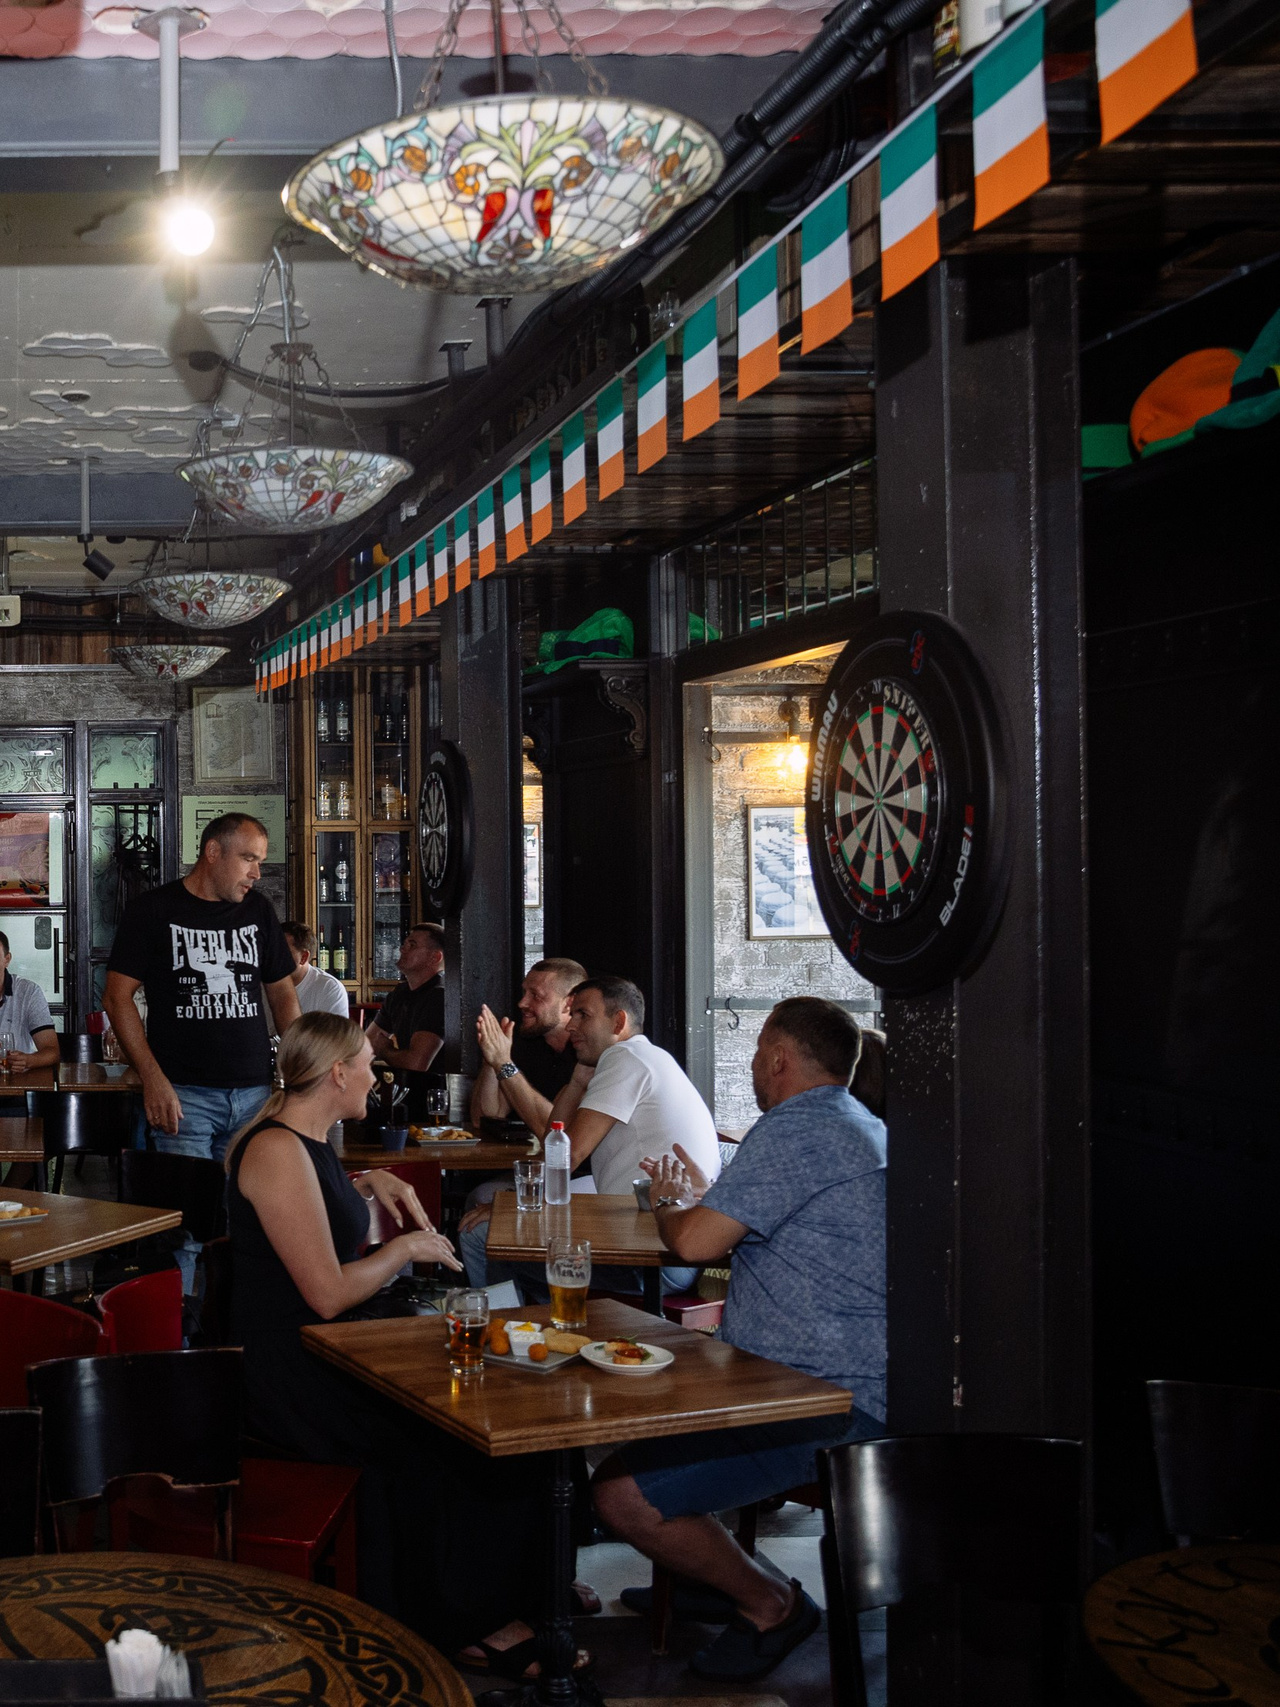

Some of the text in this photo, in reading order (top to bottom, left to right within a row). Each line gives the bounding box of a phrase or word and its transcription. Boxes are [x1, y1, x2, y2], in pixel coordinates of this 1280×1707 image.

[811, 689, 838, 802] WINMAU
[169, 923, 259, 971] EVERLAST
[240, 974, 253, 982] NYC
[191, 991, 249, 1007] BOXING
[176, 1003, 258, 1020] EQUIPMENT
